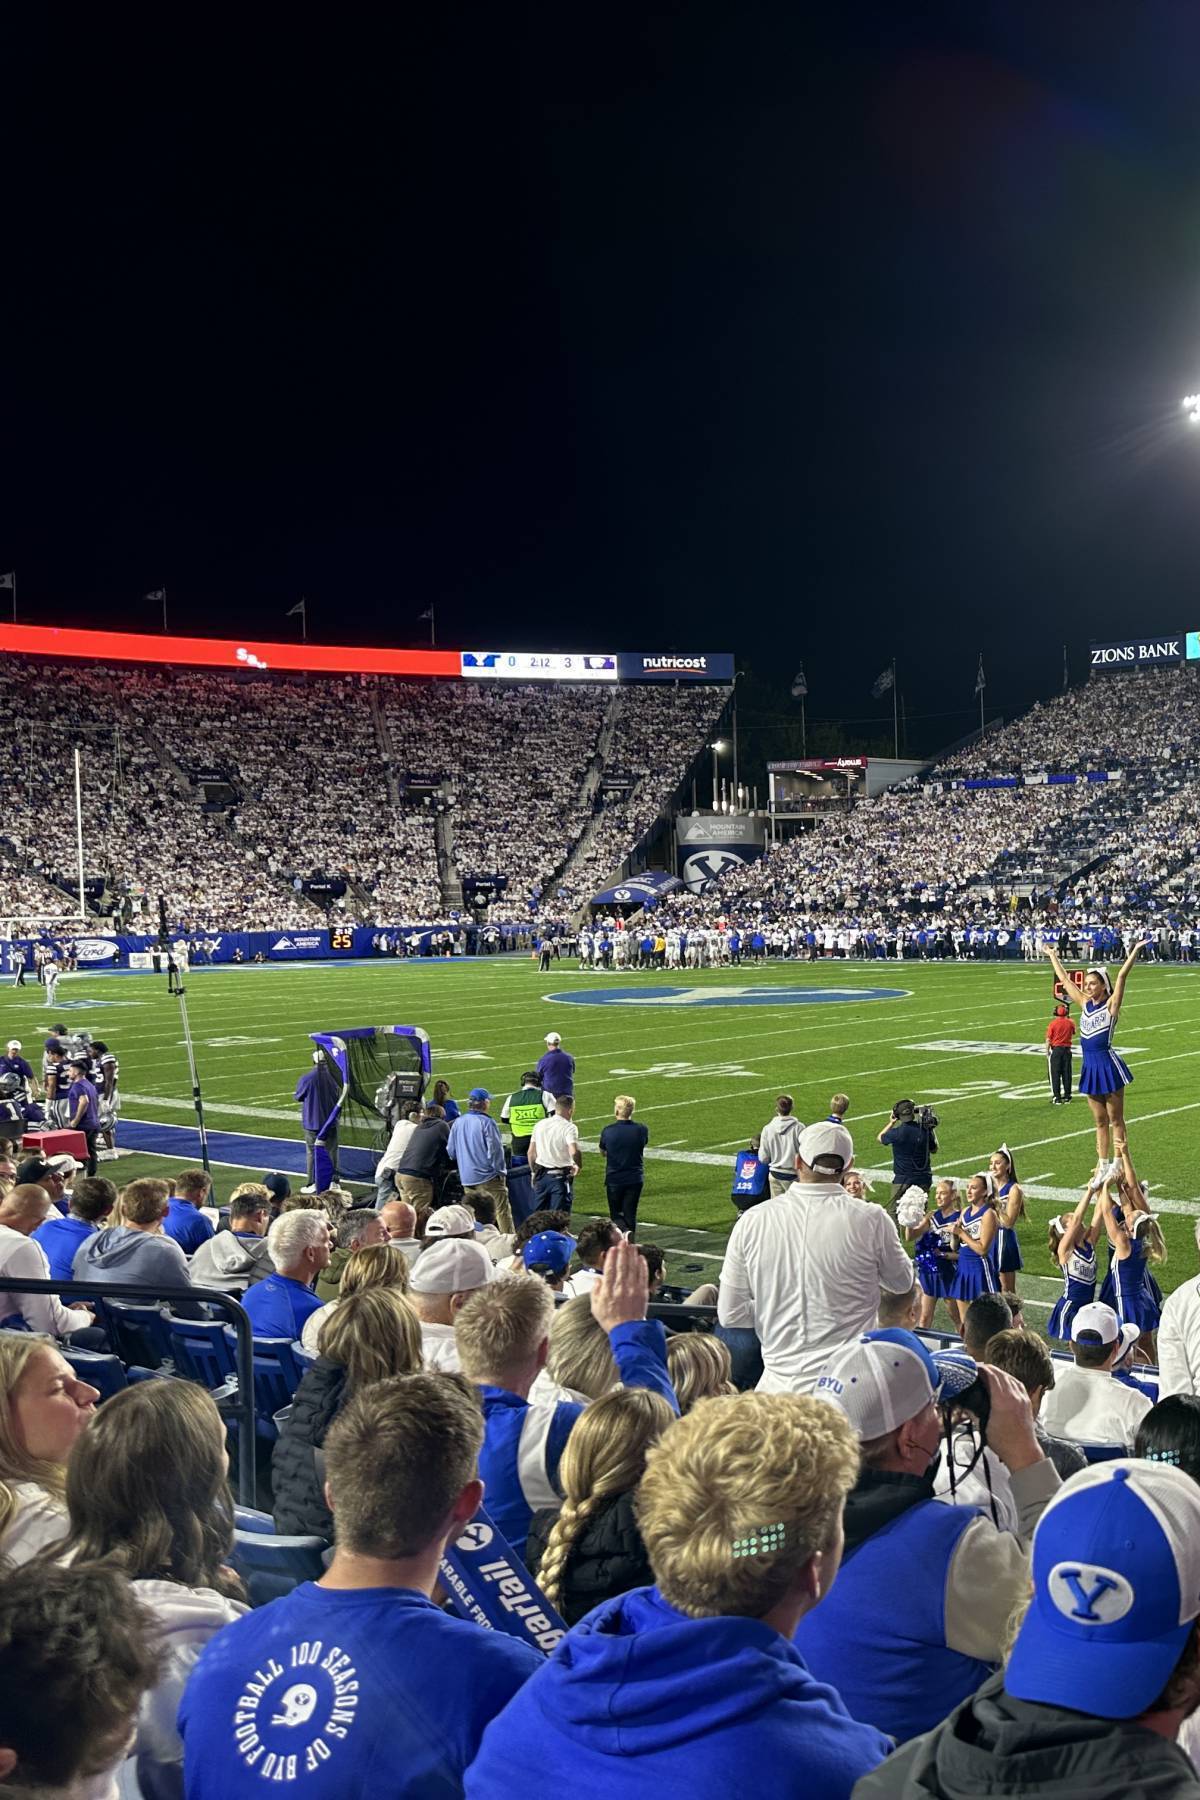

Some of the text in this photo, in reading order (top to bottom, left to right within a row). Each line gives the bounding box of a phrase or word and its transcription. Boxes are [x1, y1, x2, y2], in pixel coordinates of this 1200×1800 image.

[1091, 641, 1180, 664] ZIONS BANK
[530, 656, 551, 668] 2:12
[564, 658, 572, 669] 3
[643, 656, 706, 669] nutricost
[709, 823, 746, 831] MOUNTAIN
[77, 943, 107, 956] Ford
[332, 935, 352, 948] 25
[736, 1182, 753, 1191] 125
[817, 1376, 844, 1395] BYU
[440, 1553, 475, 1607] ARABLE
[1059, 1569, 1119, 1621] Y
[478, 1559, 566, 1658] garTail
[235, 1640, 359, 1780] 100 SEASONS OF BYU FOOTBALL
